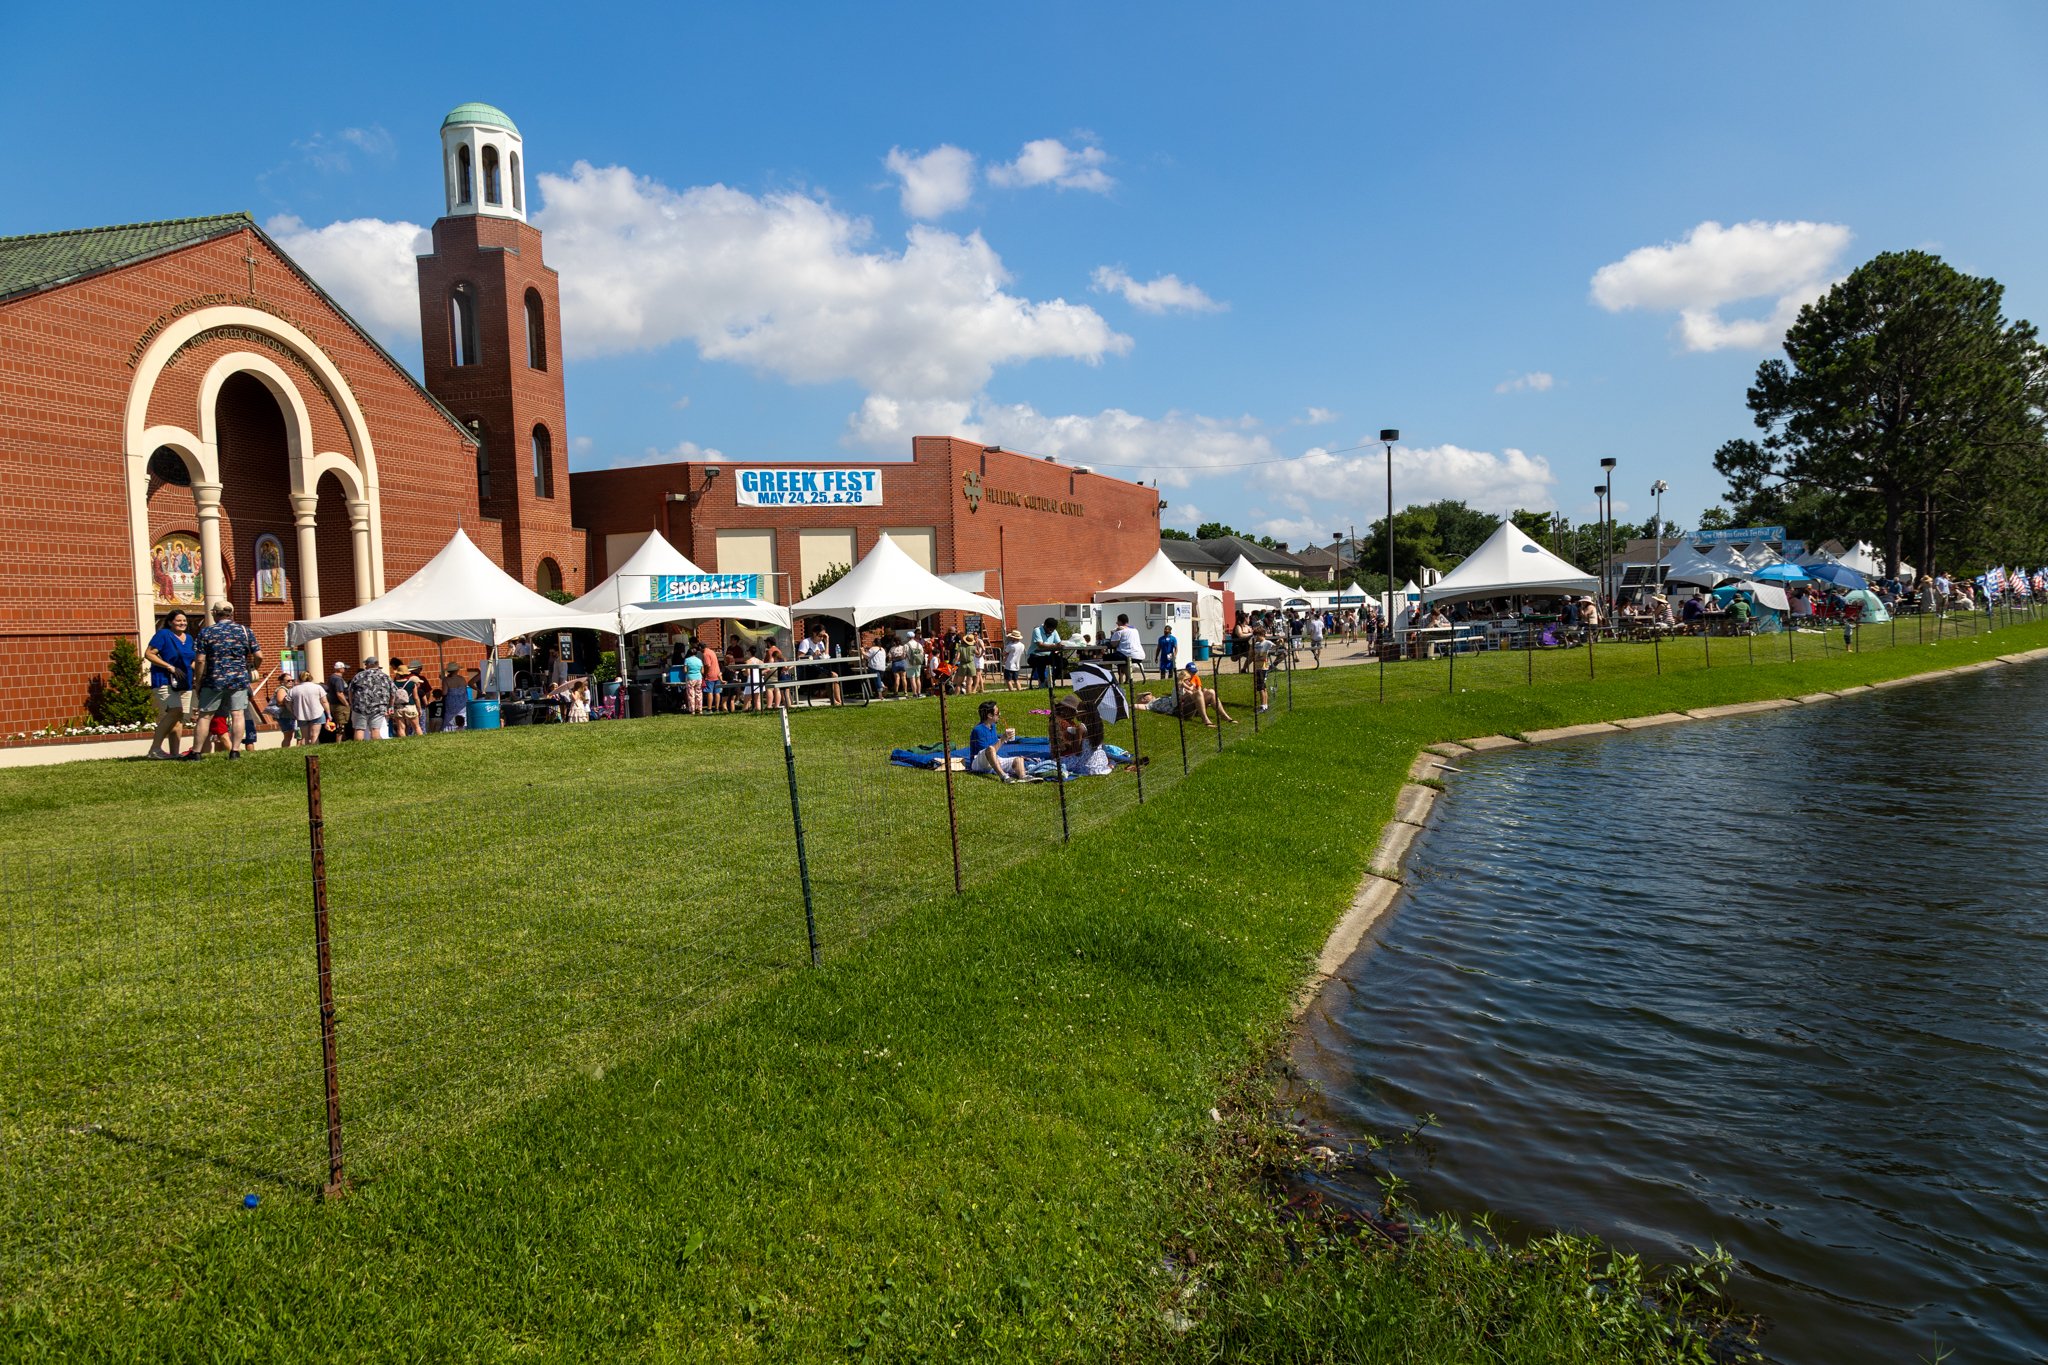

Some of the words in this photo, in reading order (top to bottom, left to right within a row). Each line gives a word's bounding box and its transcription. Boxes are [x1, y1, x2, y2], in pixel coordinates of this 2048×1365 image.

[217, 328, 246, 340] GREEK
[245, 330, 293, 361] ORTHODOX
[742, 471, 818, 492] GREEK
[823, 471, 876, 491] FEST
[758, 492, 785, 504] MAY
[788, 492, 808, 504] 24,
[810, 492, 831, 504] 25,
[833, 493, 843, 503] &
[845, 491, 863, 503] 26
[1733, 530, 1749, 538] Greek
[1749, 528, 1770, 537] Festival
[669, 580, 746, 595] SNOBALLS
